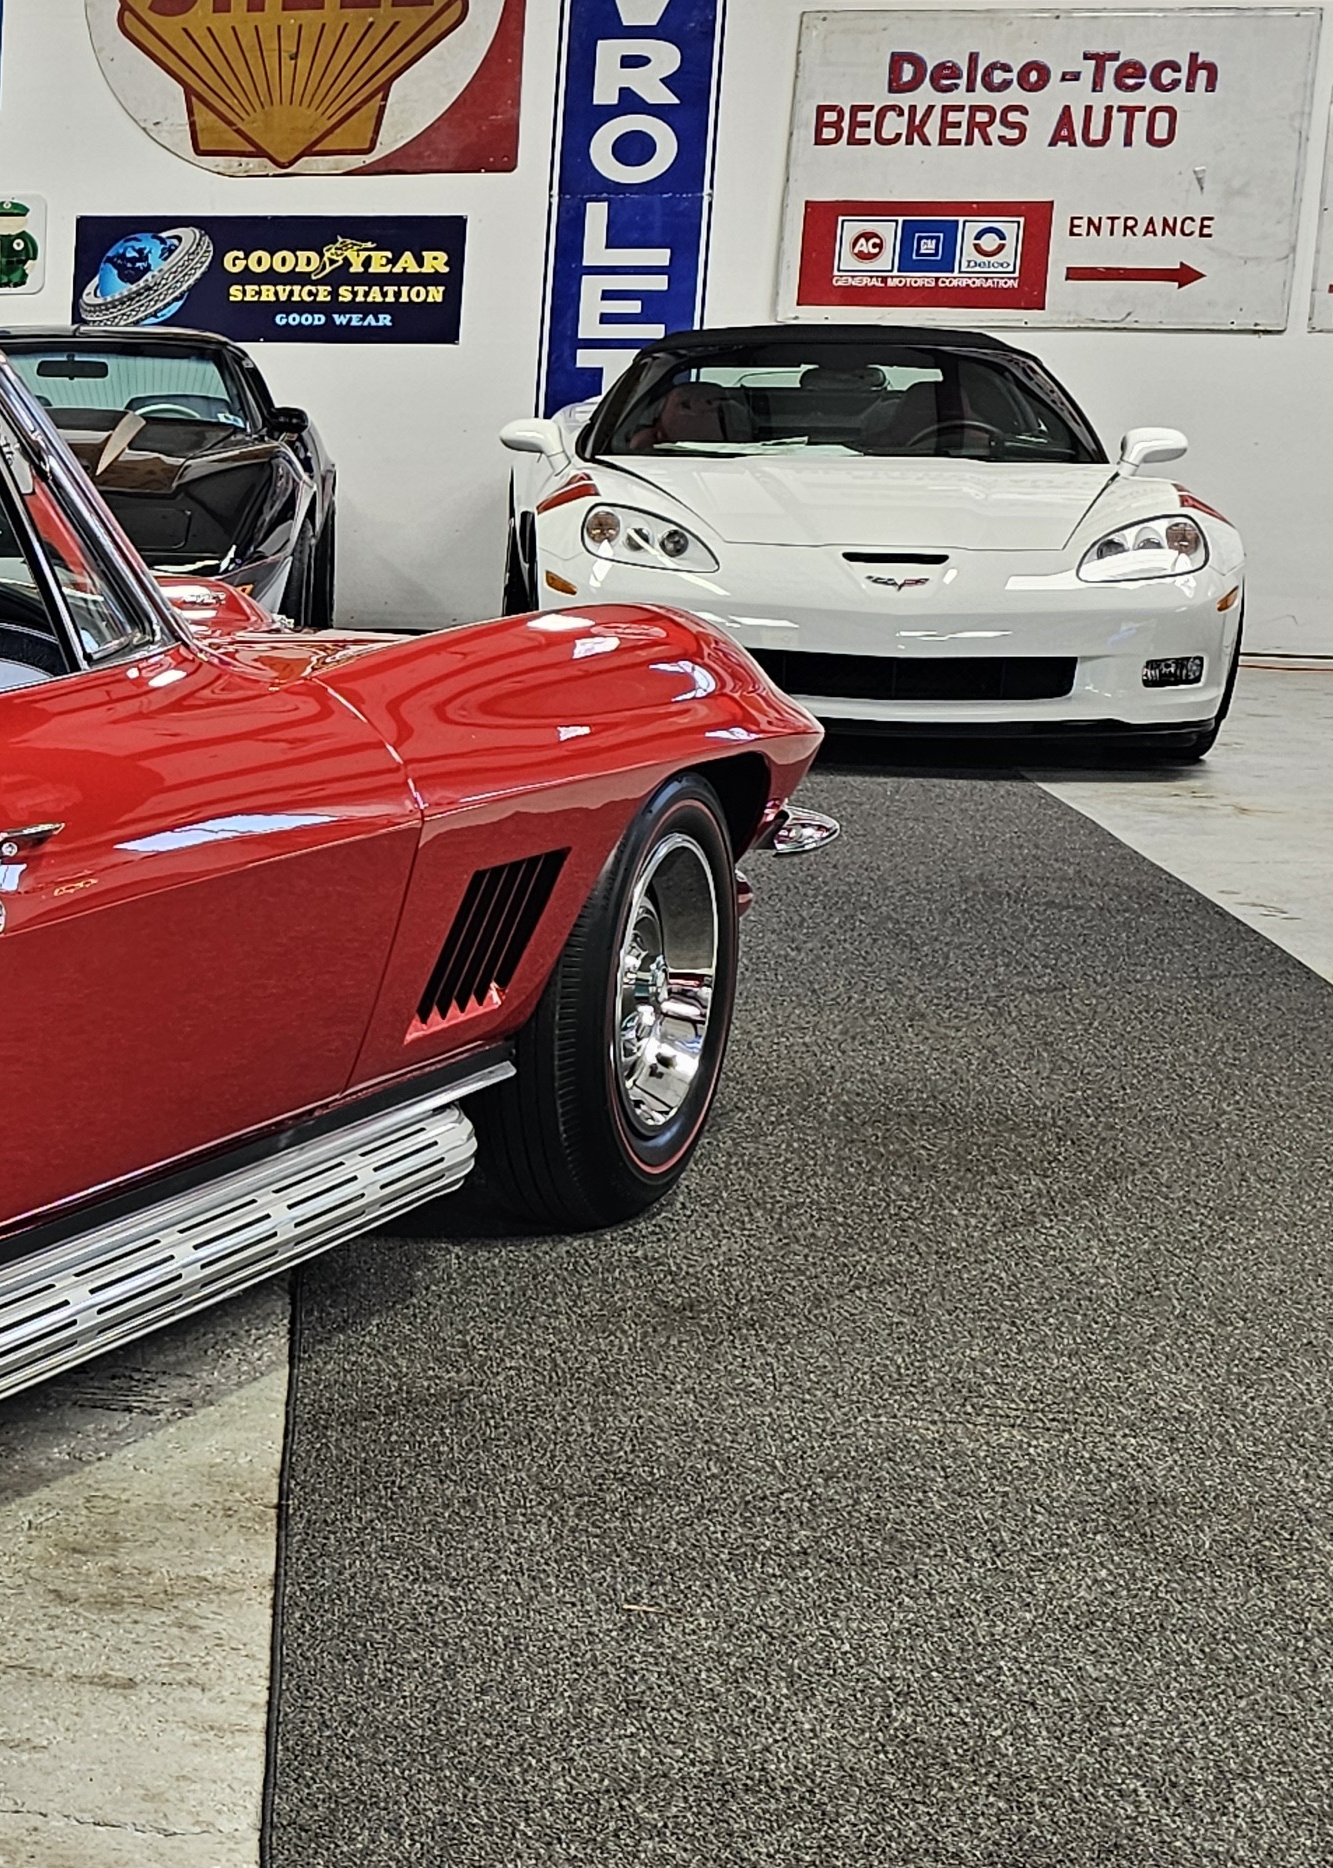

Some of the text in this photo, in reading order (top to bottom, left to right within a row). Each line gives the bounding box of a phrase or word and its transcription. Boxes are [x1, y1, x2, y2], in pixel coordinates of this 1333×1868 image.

[812, 104, 1179, 148] BECKERS AUTO
[1068, 216, 1215, 238] ENTRANCE
[853, 236, 881, 254] AC
[965, 259, 1011, 269] Delco
[833, 276, 1019, 289] GENERAL MOTORS CORPORATION
[229, 284, 445, 303] SERVICE STATION
[274, 313, 393, 327] GOOD WEAR
